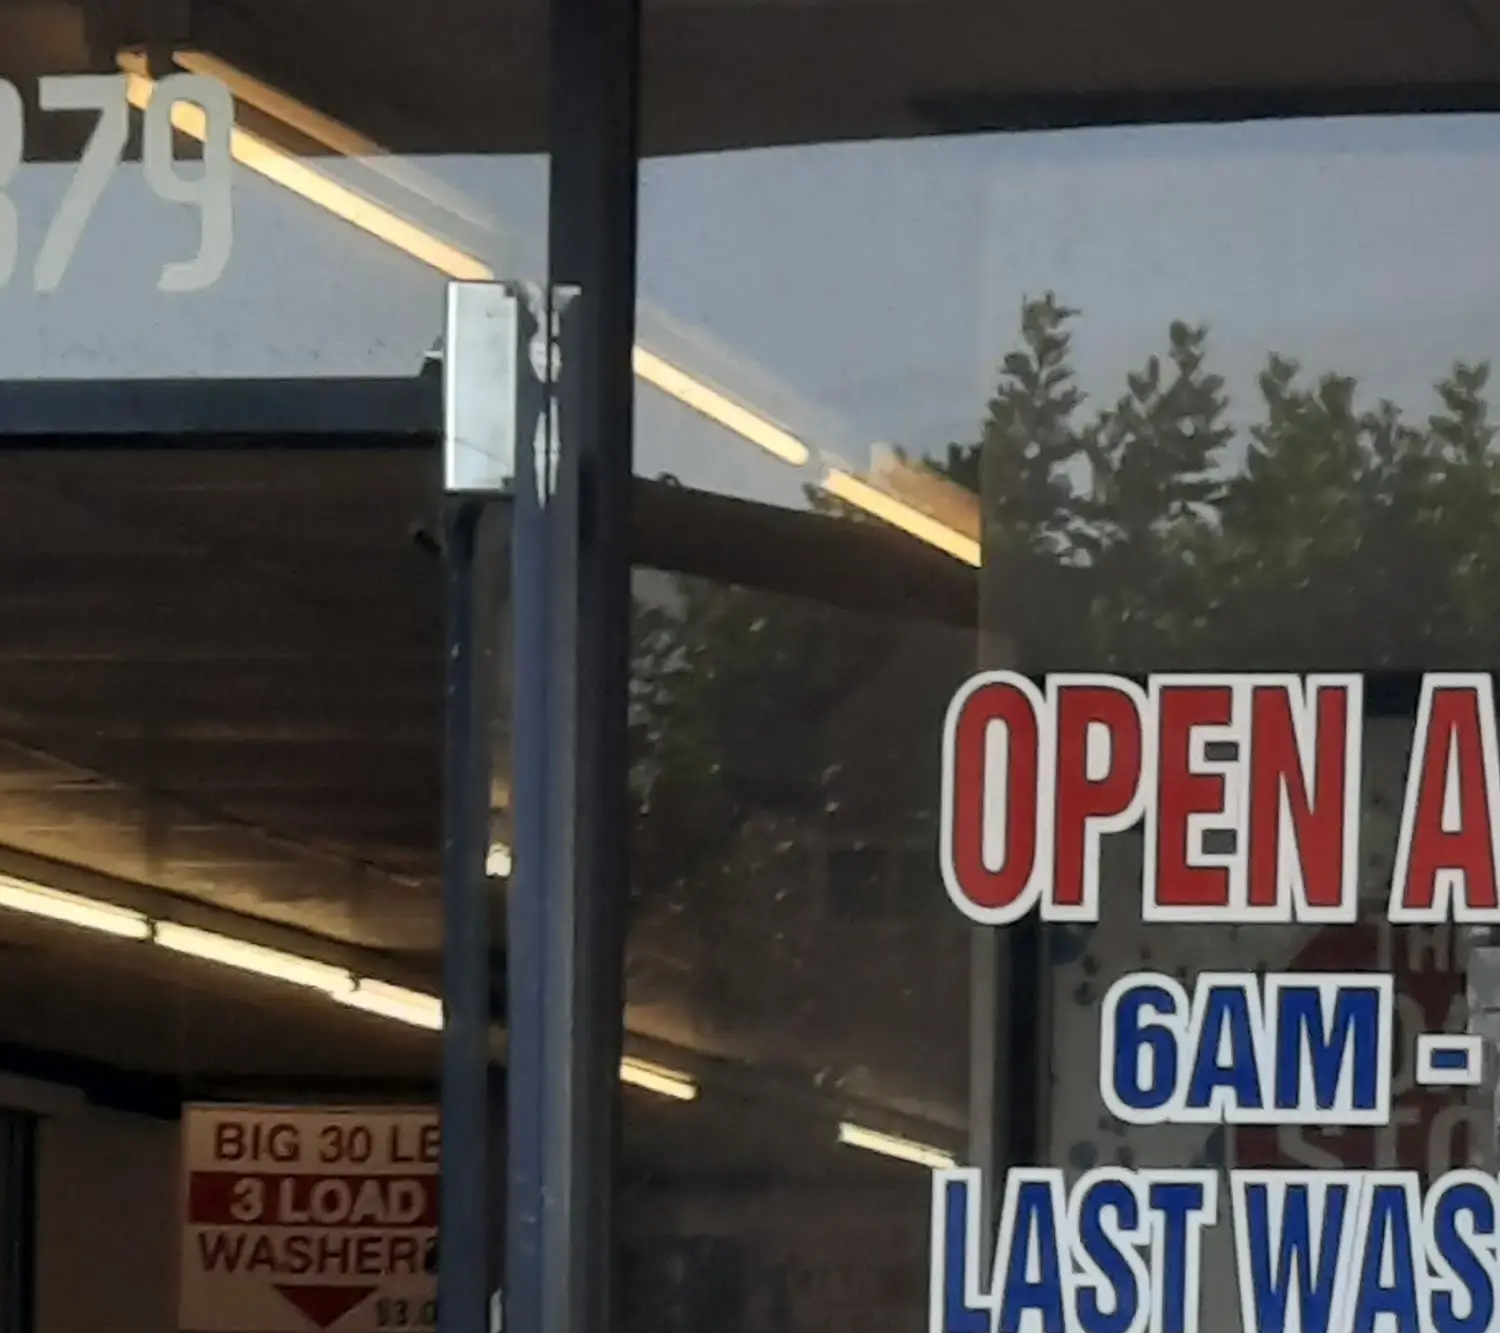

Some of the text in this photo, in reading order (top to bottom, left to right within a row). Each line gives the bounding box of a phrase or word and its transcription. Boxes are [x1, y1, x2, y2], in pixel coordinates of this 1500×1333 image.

[0, 74, 235, 293] 79
[940, 671, 1363, 924] OPEN
[1102, 972, 1393, 1124] 6AM
[213, 1121, 300, 1163] BIG
[318, 1124, 373, 1164] 30
[229, 1175, 428, 1225] 3 LOAD
